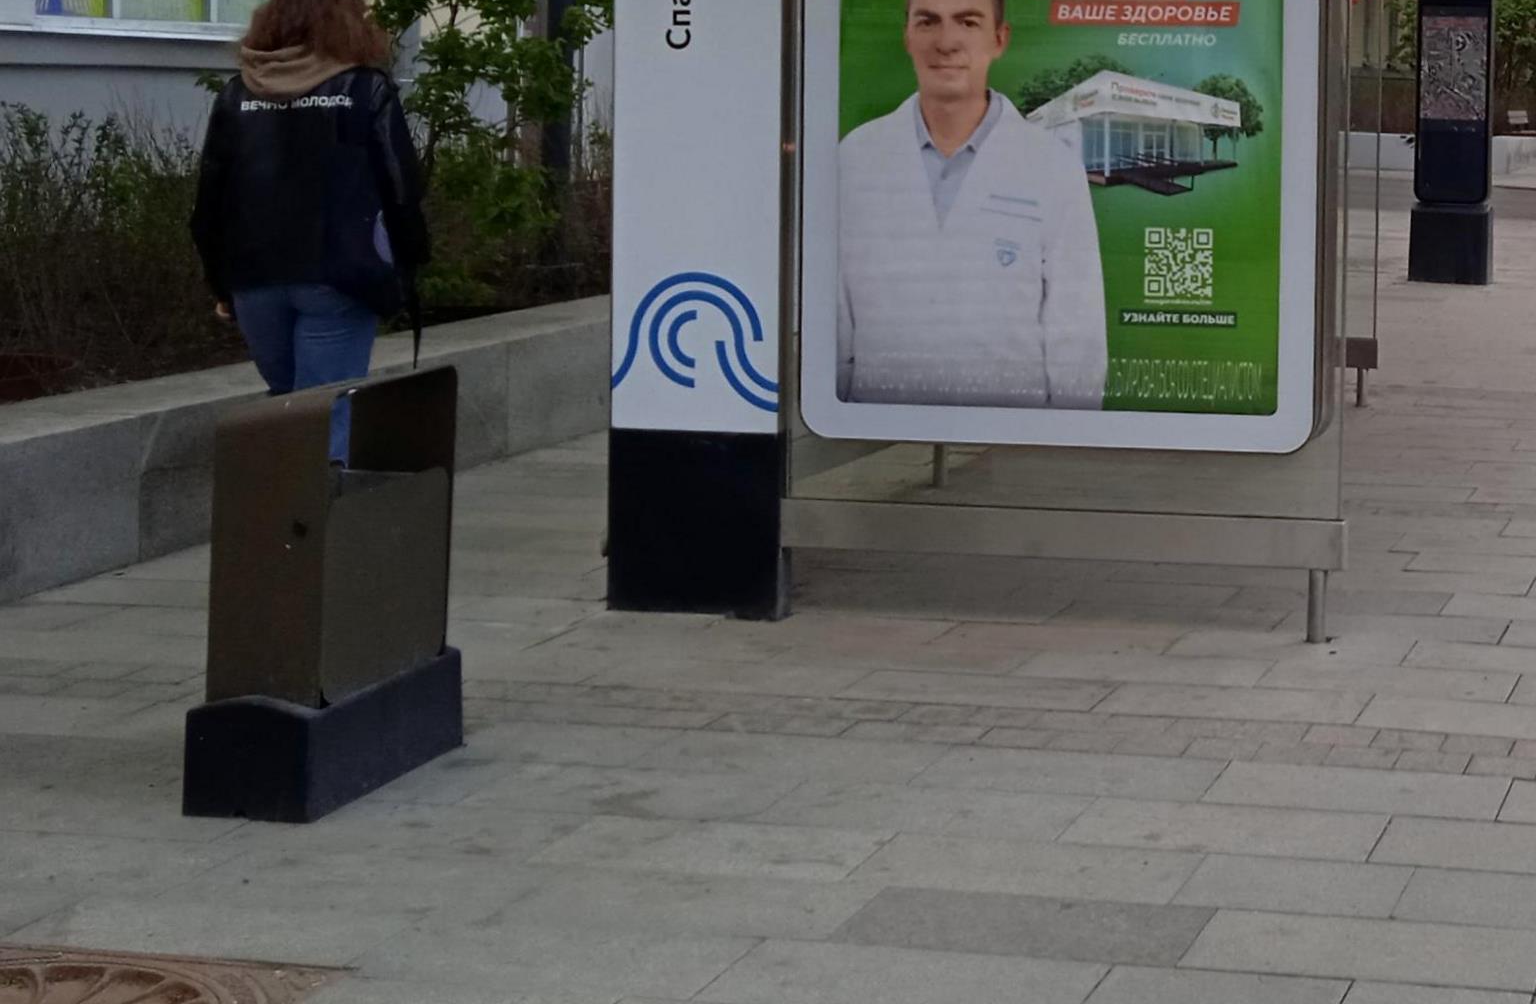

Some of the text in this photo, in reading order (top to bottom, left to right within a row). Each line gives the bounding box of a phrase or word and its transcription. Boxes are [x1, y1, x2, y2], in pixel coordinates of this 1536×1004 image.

[1057, 4, 1233, 23] ВАШЕ ЗДОРОВЬЕ
[1117, 32, 1217, 47] БЕСПЛАТНО
[1122, 311, 1235, 325] УЗНАЙТЕ БОЛЬШЕ
